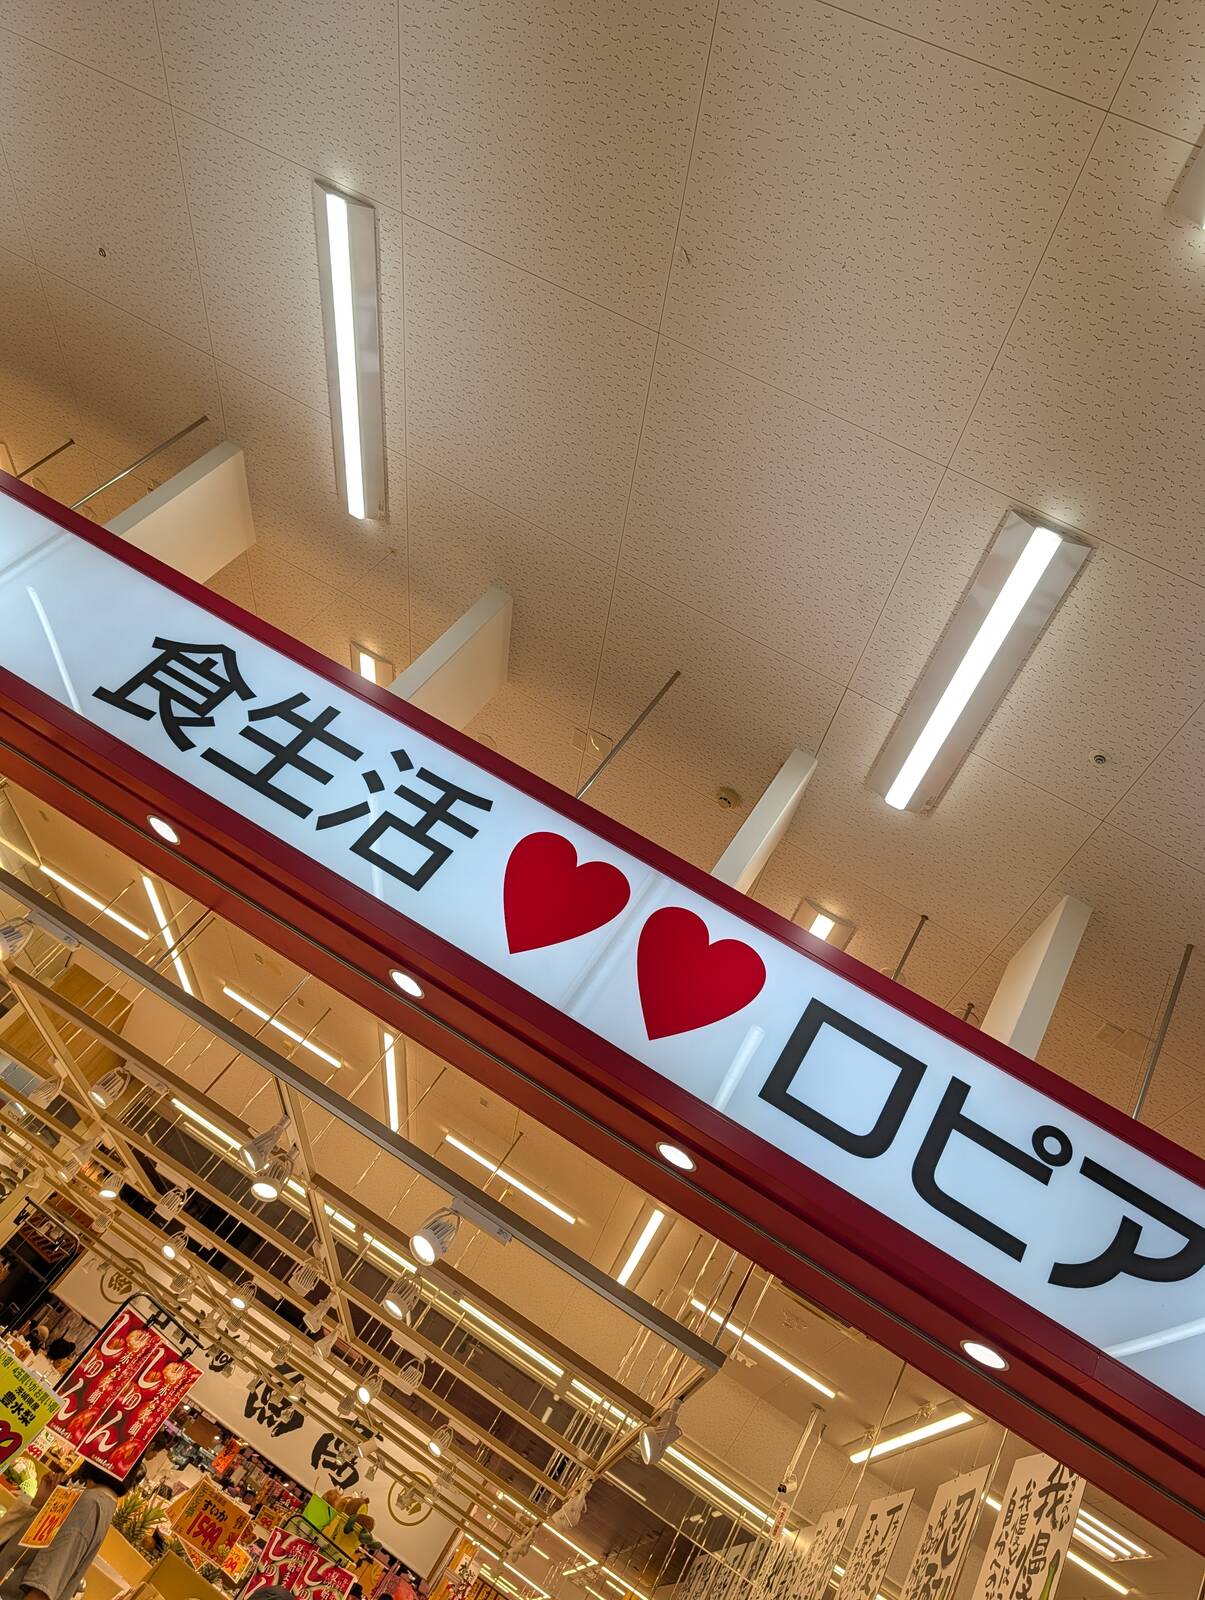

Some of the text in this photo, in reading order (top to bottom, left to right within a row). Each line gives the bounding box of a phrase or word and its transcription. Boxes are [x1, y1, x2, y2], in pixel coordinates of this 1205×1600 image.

[92, 636, 1205, 1289] 食生活 ロピア
[0, 1390, 37, 1427] 豊水梨
[84, 1347, 165, 1452] しゅん
[201, 1499, 228, 1522] すいか
